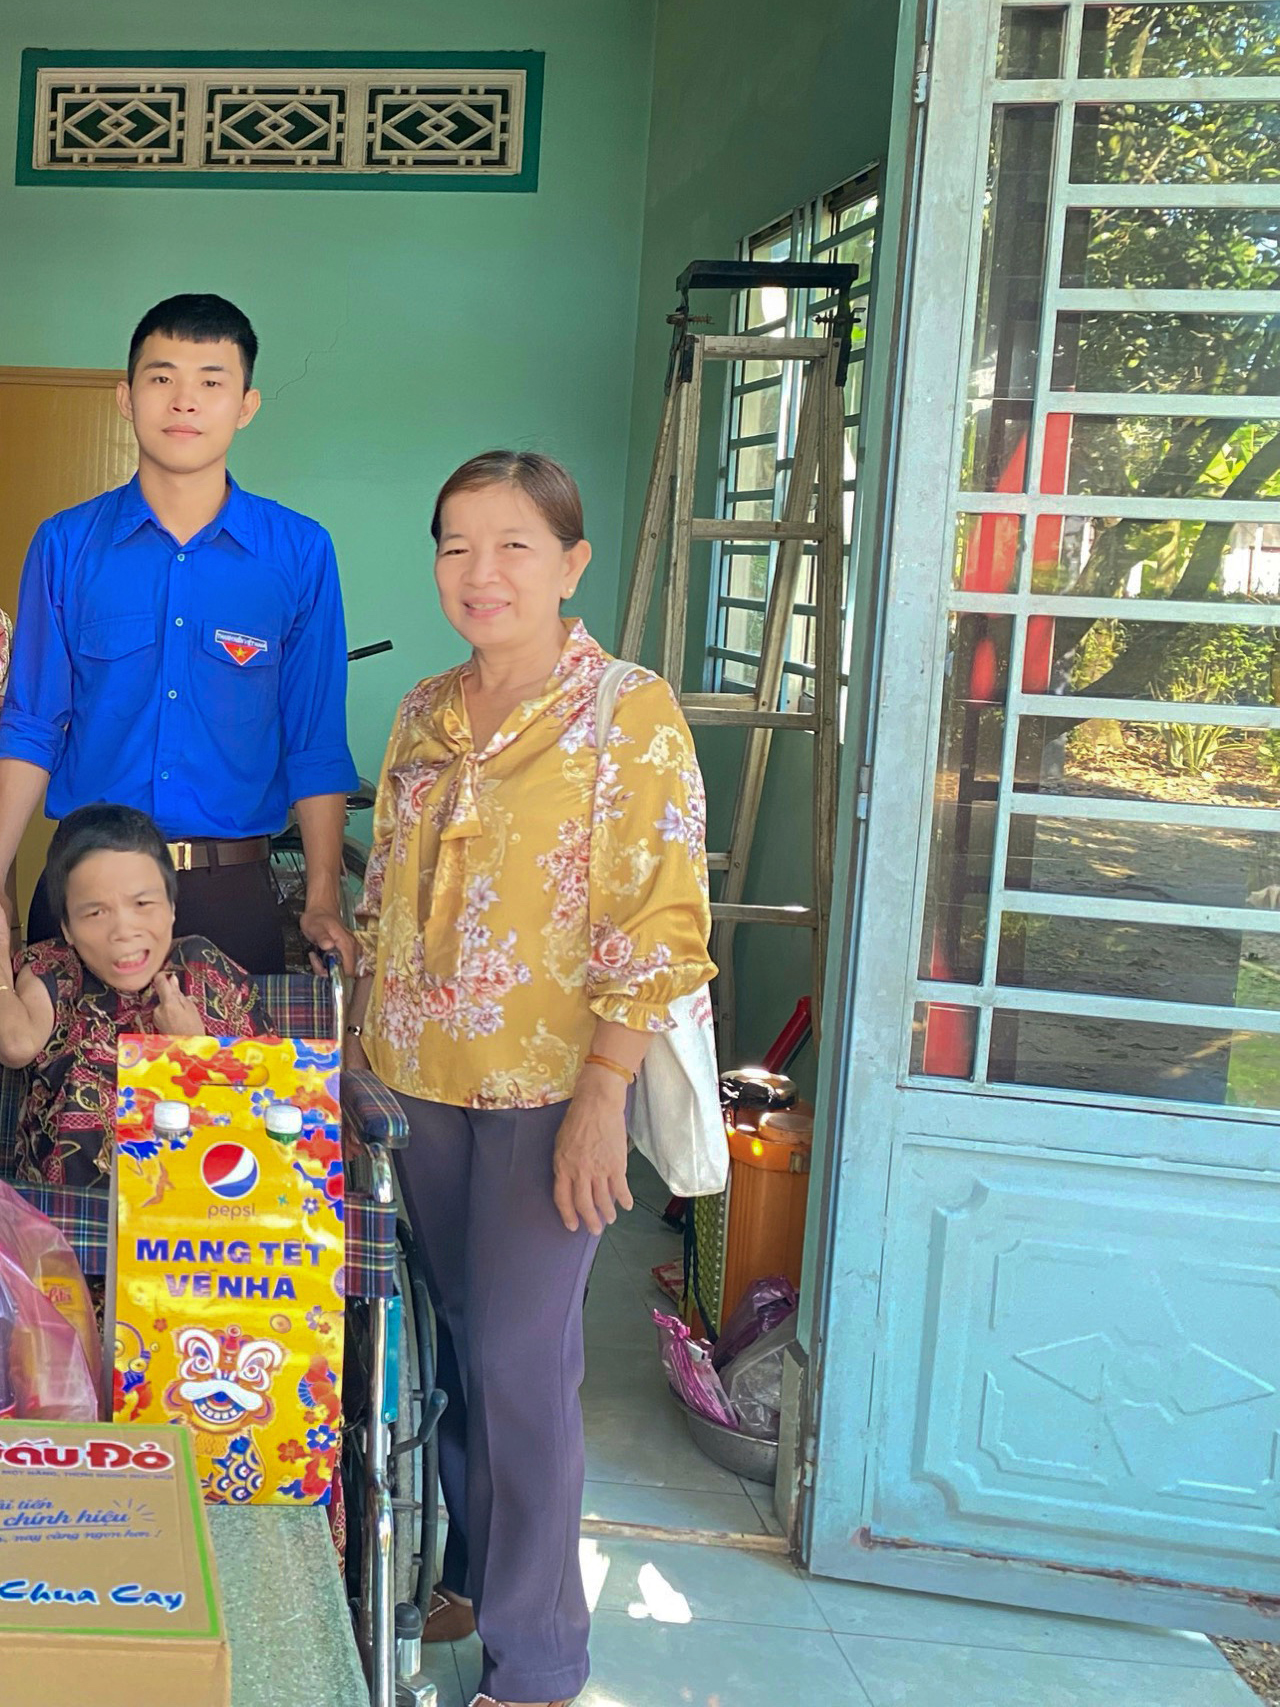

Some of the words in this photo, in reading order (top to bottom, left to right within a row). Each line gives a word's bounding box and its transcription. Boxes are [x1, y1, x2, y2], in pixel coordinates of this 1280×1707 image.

[208, 1203, 255, 1220] pepsi
[136, 1239, 251, 1264] MANG
[85, 1441, 173, 1471] Đỏ
[3, 1510, 70, 1527] chính
[76, 1509, 131, 1526] hiệu
[111, 1585, 183, 1611] Cay
